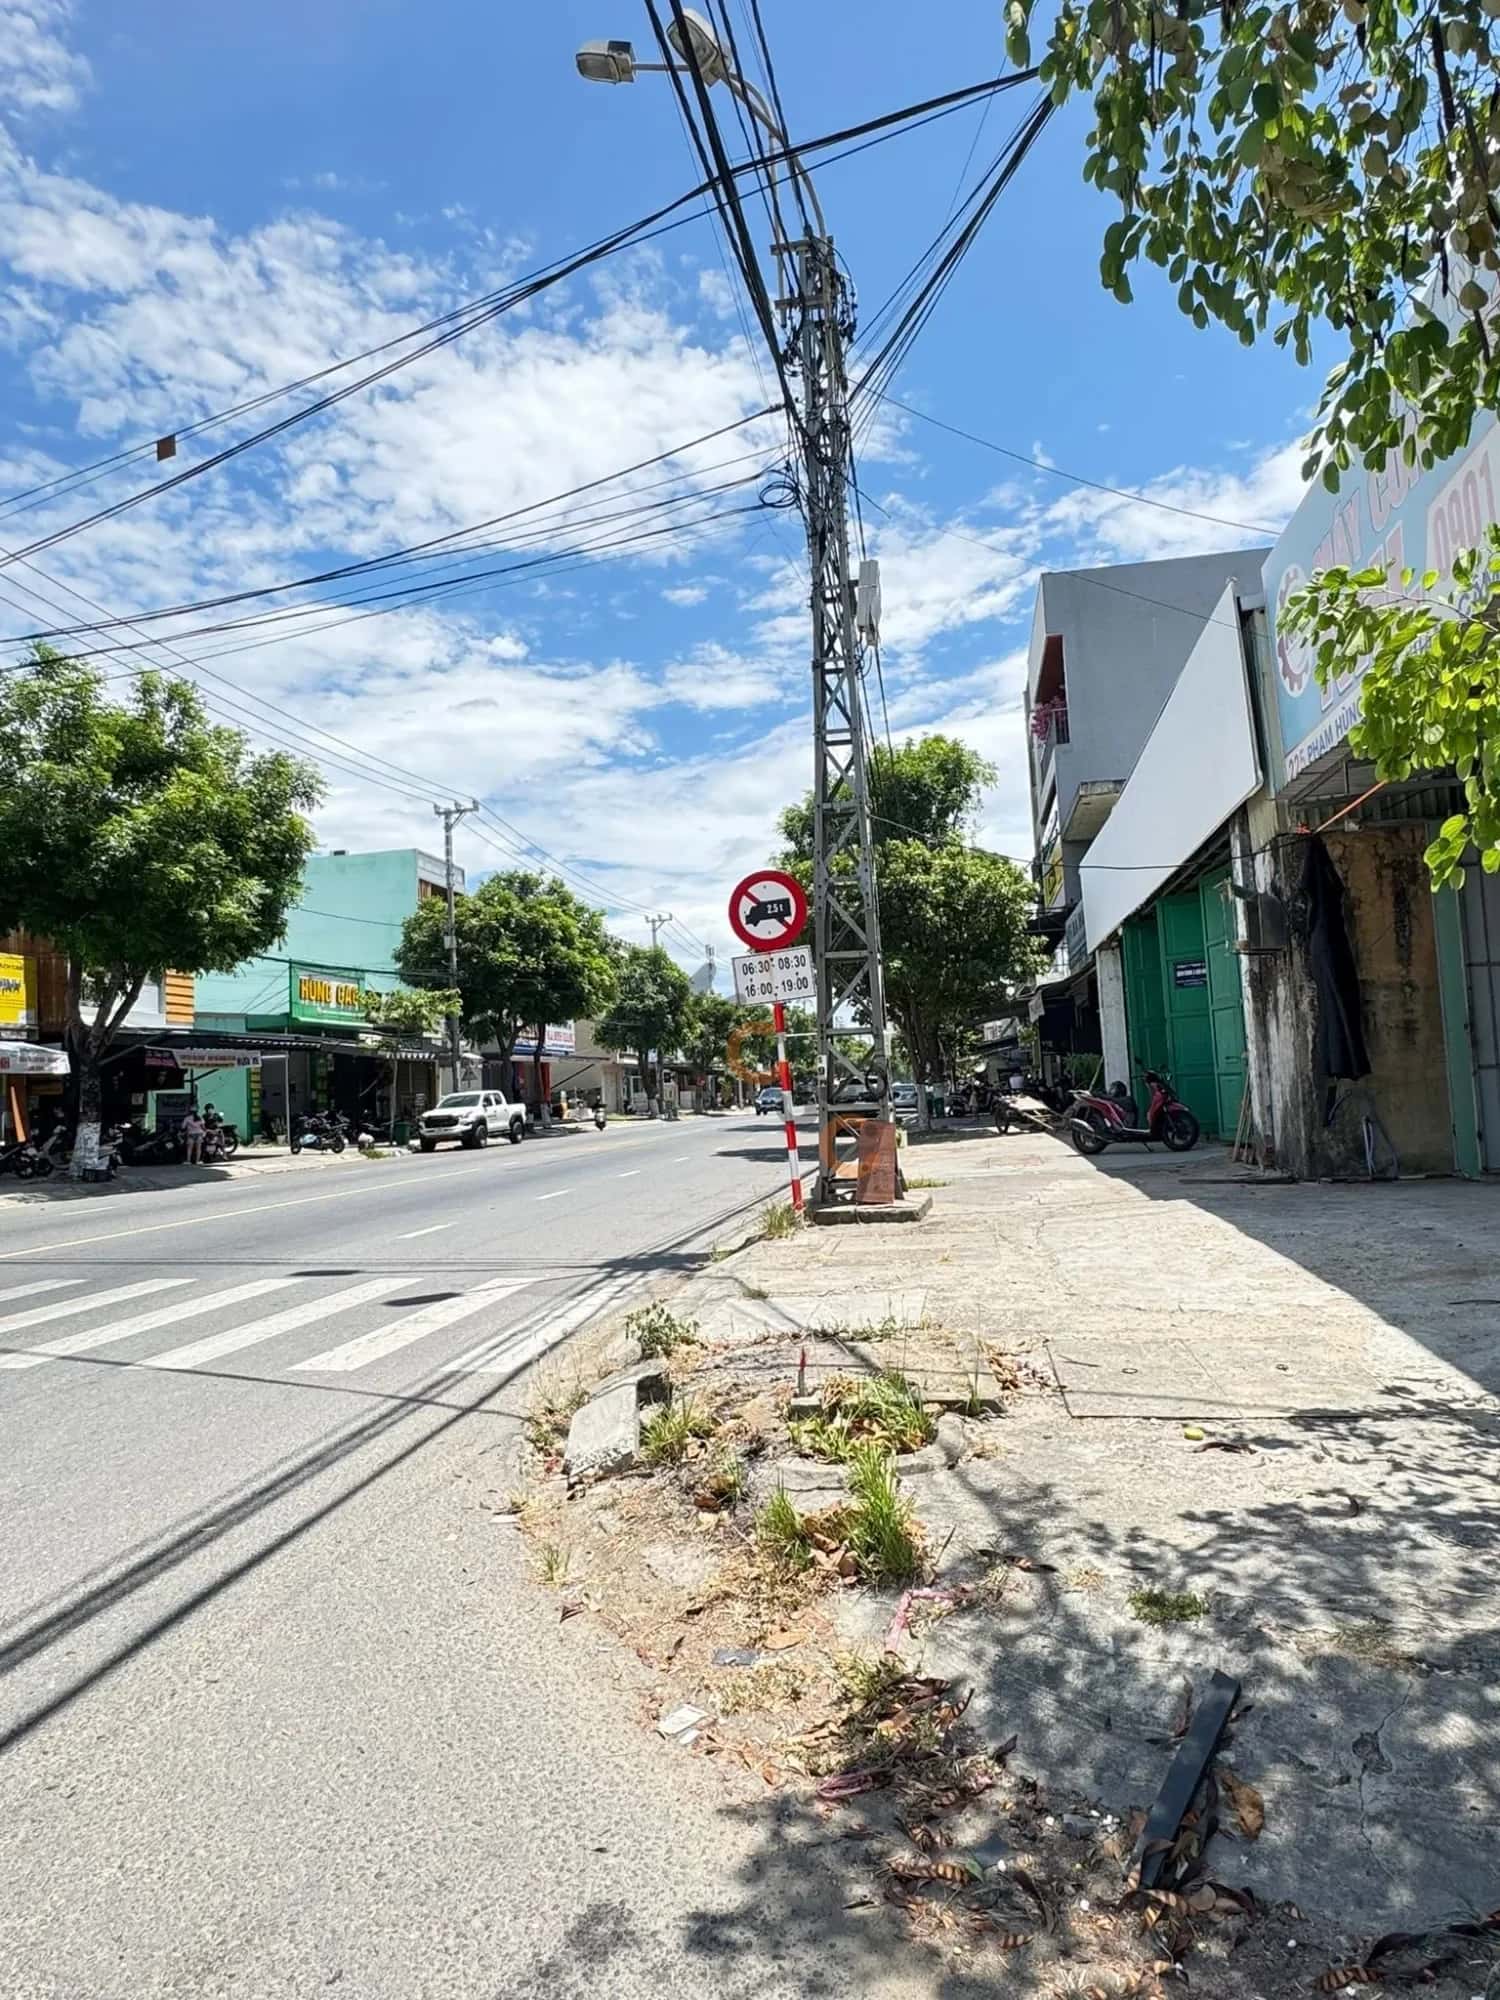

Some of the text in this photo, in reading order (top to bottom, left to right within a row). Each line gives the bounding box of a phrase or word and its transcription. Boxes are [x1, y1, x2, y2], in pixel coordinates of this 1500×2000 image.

[742, 959, 770, 976] 06:30
[778, 954, 806, 970] 08:30
[745, 981, 773, 998] 16:00
[782, 977, 809, 993] 19:00
